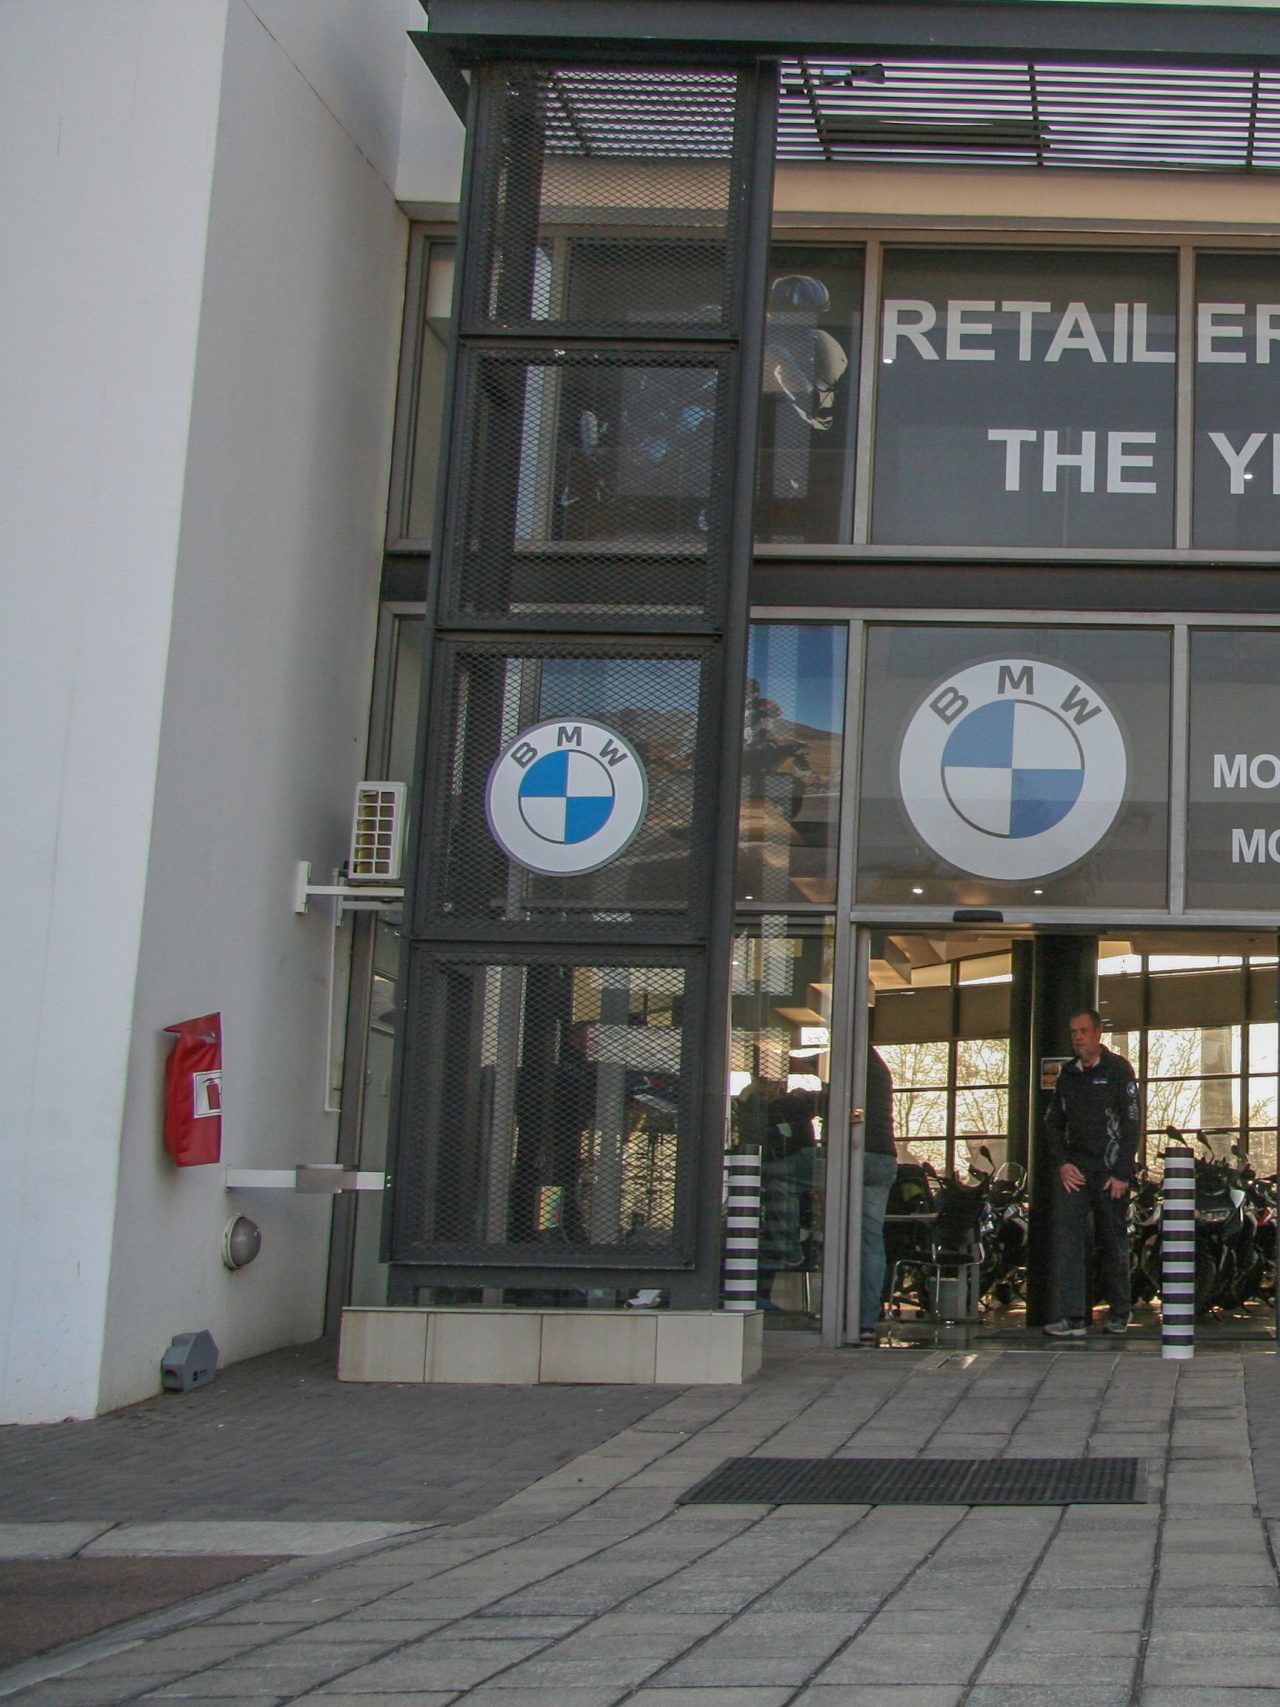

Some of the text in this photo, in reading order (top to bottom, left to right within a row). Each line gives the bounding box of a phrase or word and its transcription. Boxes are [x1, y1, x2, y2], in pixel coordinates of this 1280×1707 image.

[987, 428, 1157, 494] THE
[928, 665, 1103, 726] BMW
[510, 726, 629, 769] BMW
